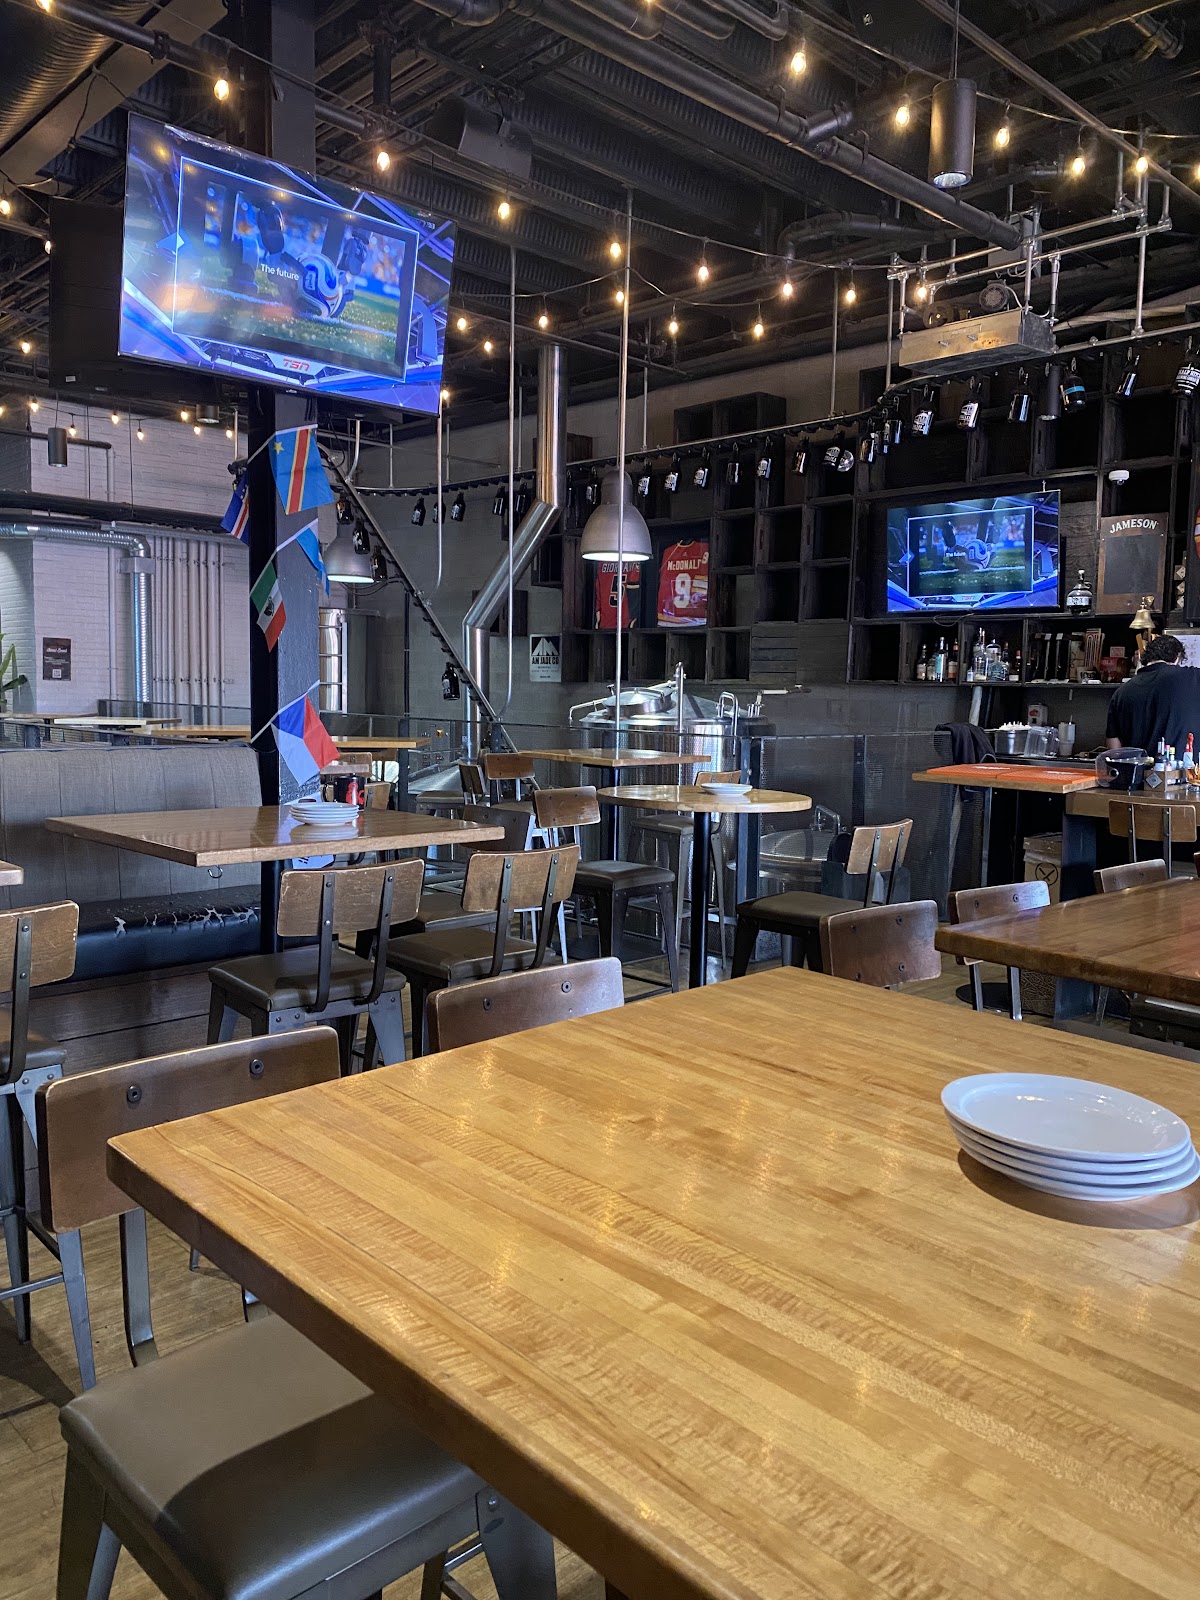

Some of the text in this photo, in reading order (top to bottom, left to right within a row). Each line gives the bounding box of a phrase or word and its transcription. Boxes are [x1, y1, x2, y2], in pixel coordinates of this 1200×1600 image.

[260, 263, 300, 281] The future
[283, 358, 310, 372] TSN
[1109, 518, 1157, 534] JAMESON
[609, 574, 627, 608] 5
[673, 573, 692, 608] 9
